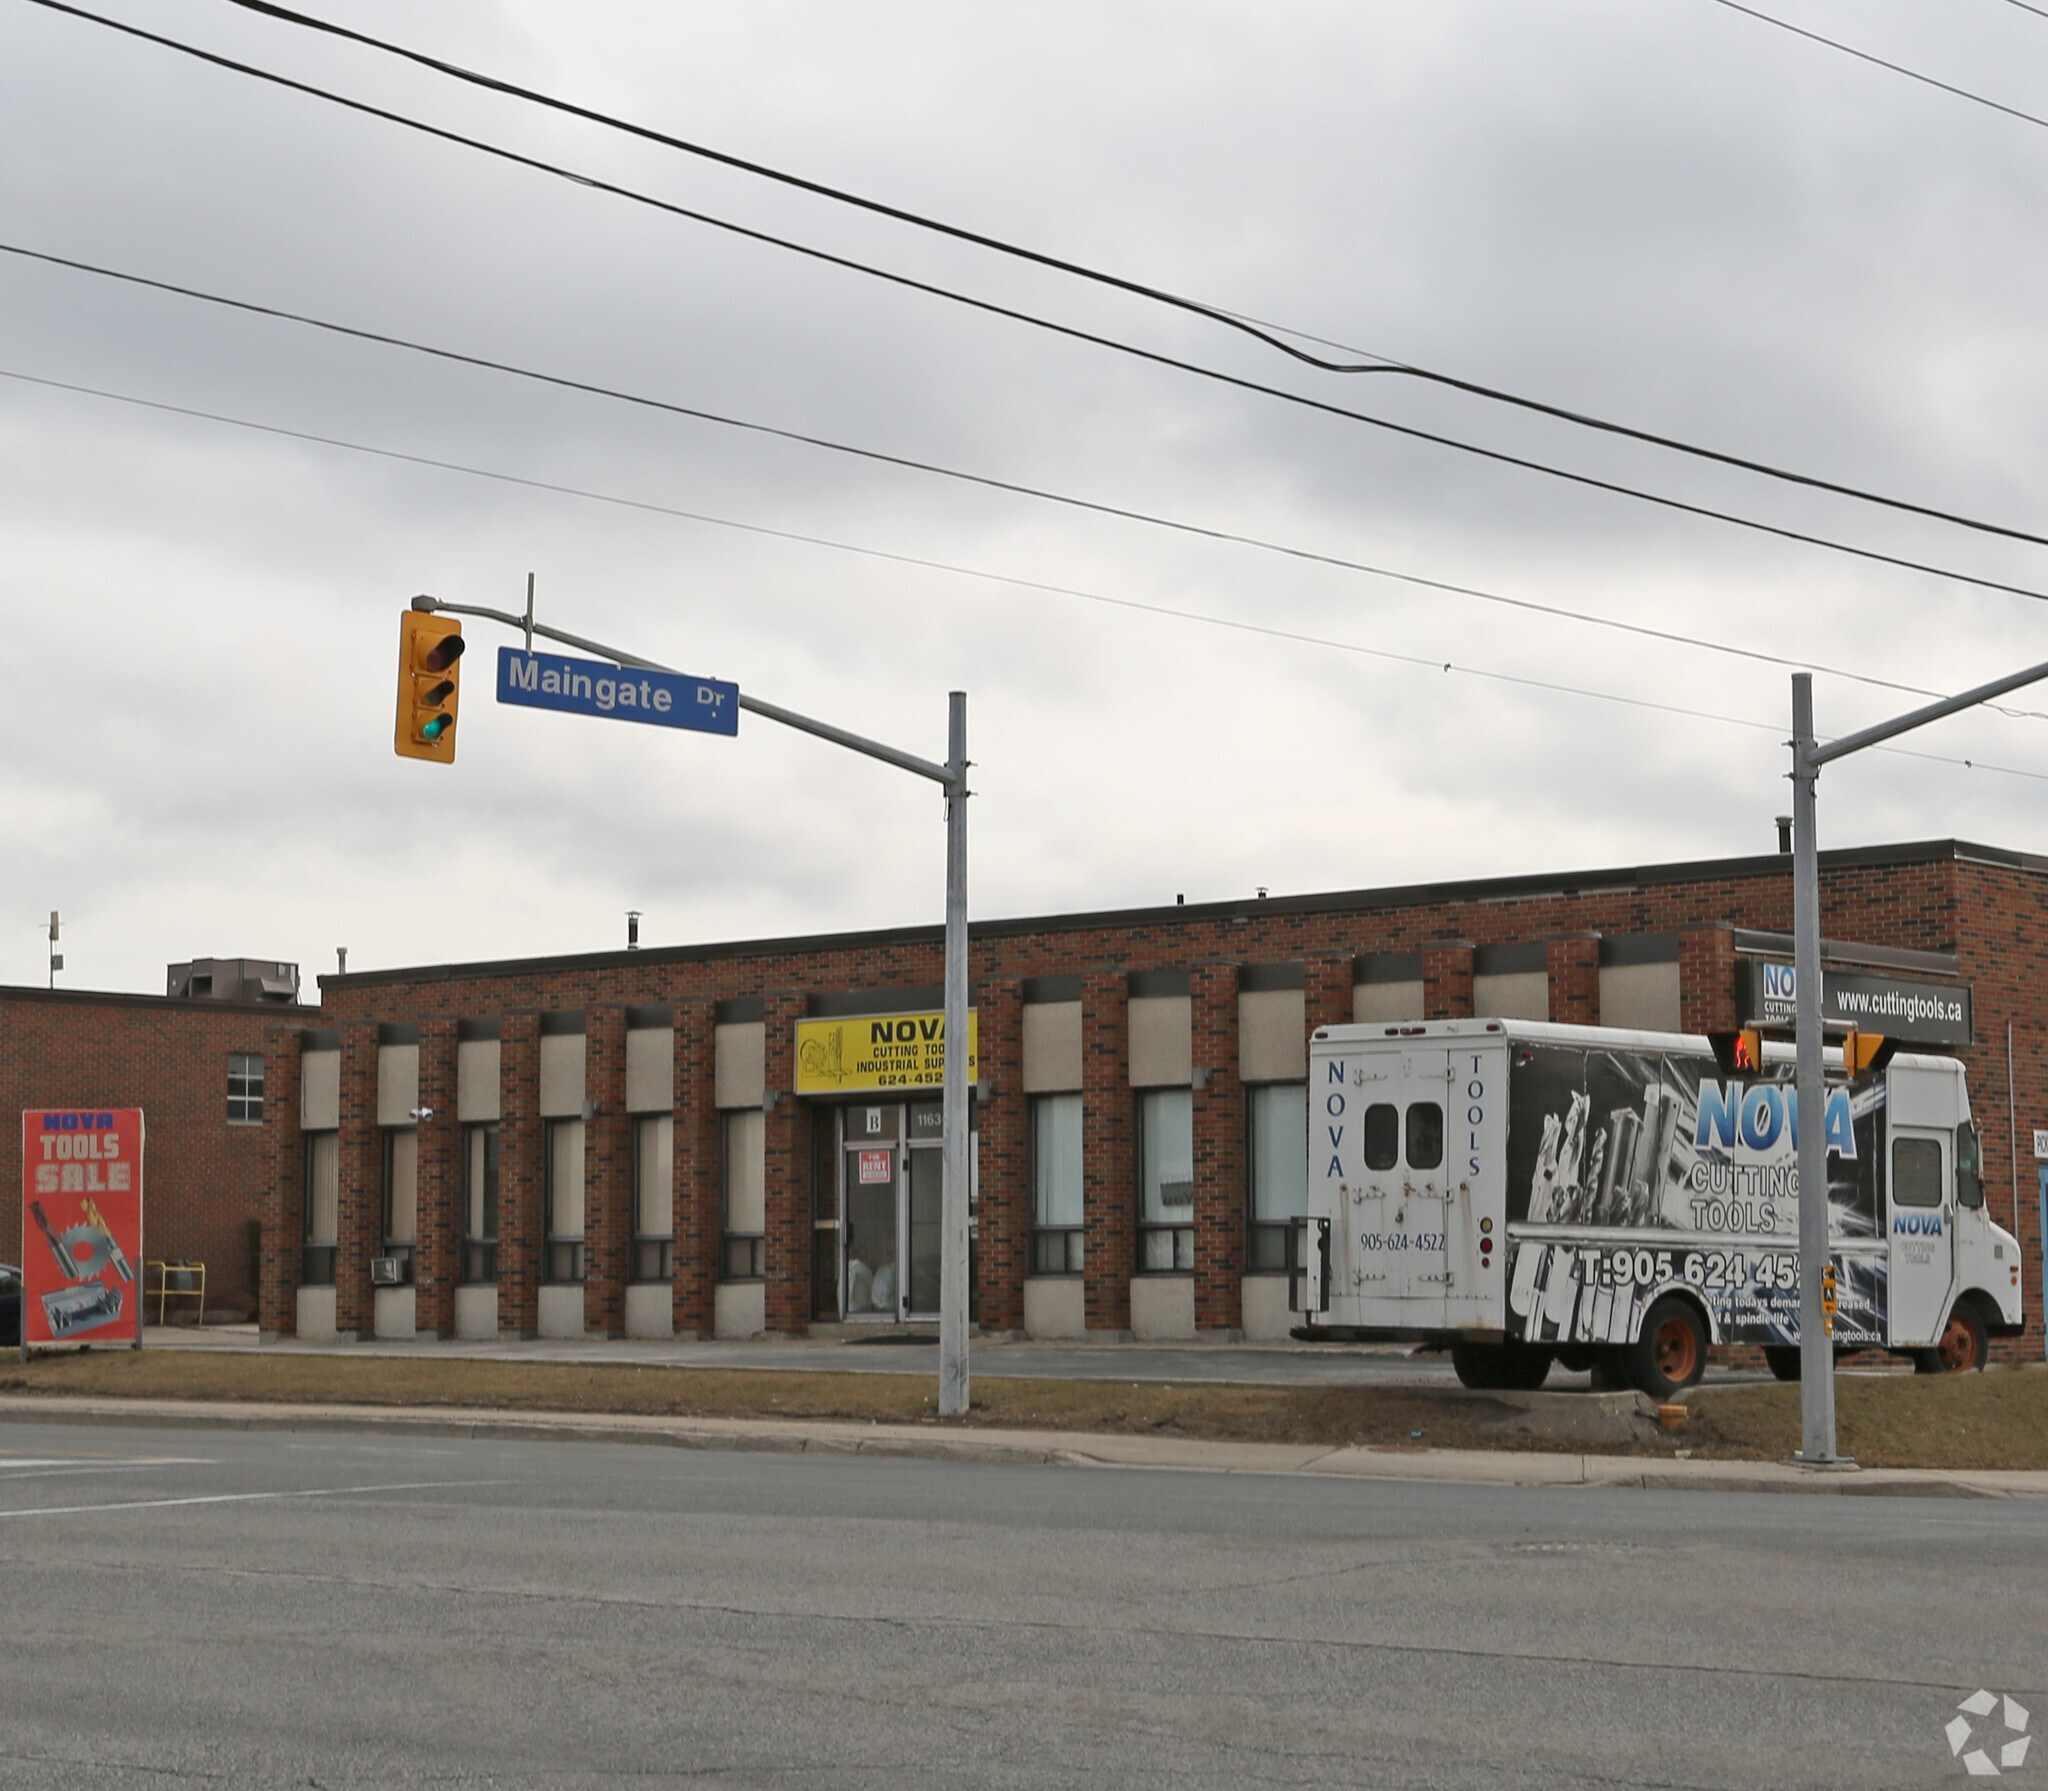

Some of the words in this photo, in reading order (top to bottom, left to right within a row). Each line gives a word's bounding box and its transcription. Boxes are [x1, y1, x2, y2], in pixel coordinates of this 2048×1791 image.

[509, 657, 673, 711] Maingate
[696, 685, 725, 707] Dr
[1765, 965, 1796, 997] NO
[1837, 990, 1962, 1023] www.cuttingtools.ca
[873, 1045, 918, 1058] CUTTING
[924, 1043, 945, 1055] TOO
[857, 1059, 919, 1073] INDUSTRIAL
[878, 1072, 944, 1086] 624-452
[44, 1114, 113, 1130] NOVA
[870, 1114, 879, 1130] B
[1326, 1060, 1346, 1178] NOVA
[1467, 1055, 1484, 1177] TOOLS
[40, 1133, 120, 1160] TOOLS
[35, 1161, 131, 1194] SALE
[1690, 1160, 1800, 1199] CUTTING
[1690, 1199, 1776, 1234] TOOLS
[1893, 1214, 1943, 1236] NOVA
[1360, 1233, 1446, 1251] 905-624-4522
[1683, 1251, 1747, 1290] 624
[1735, 1296, 1768, 1309] todays
[1735, 1312, 1770, 1326] spindle
[1772, 1312, 1789, 1325] life
